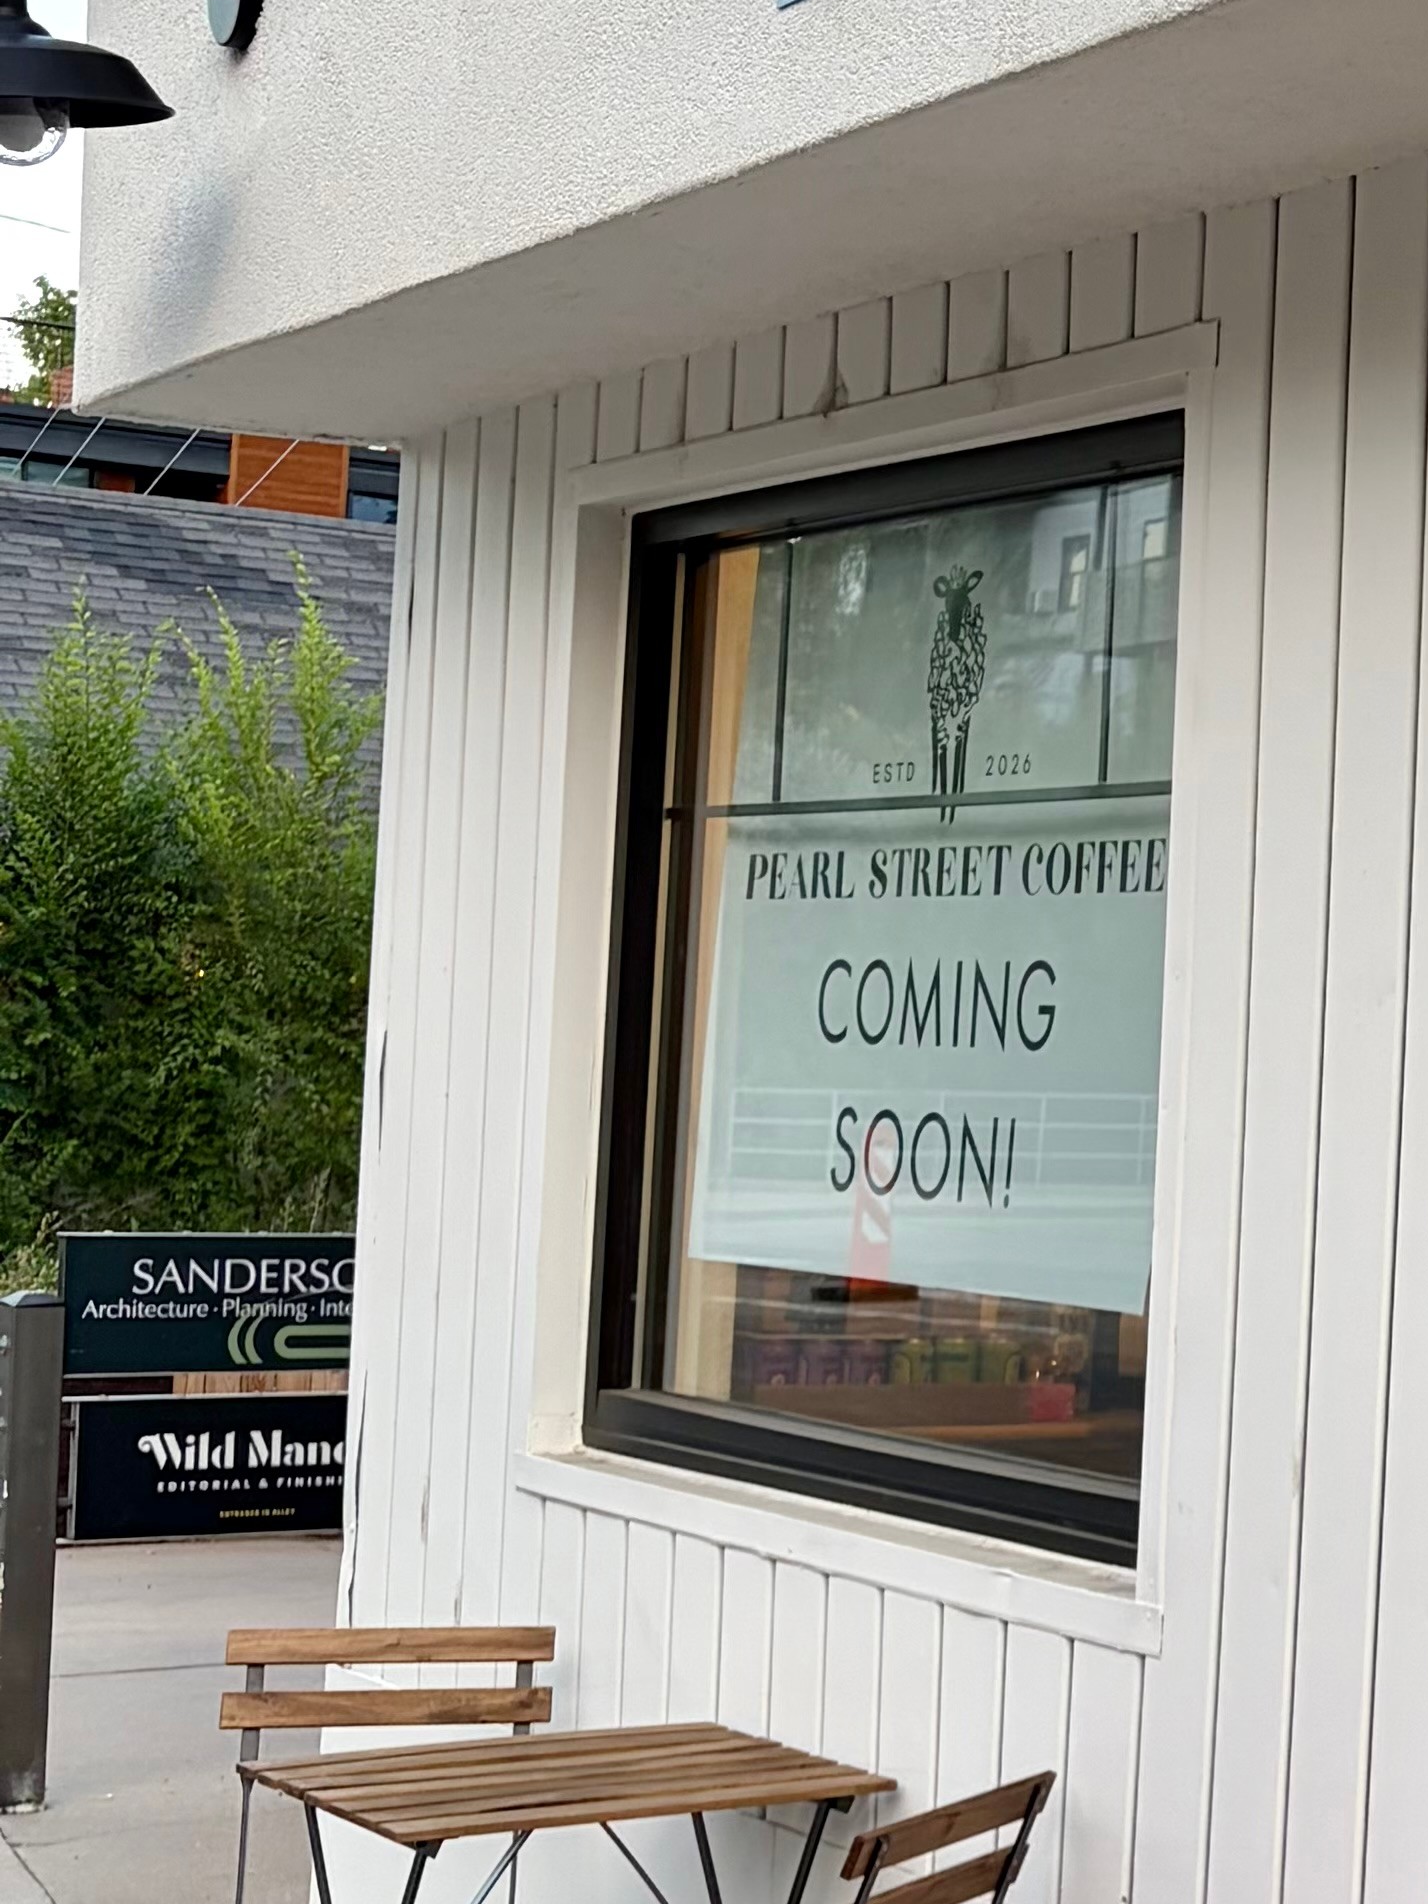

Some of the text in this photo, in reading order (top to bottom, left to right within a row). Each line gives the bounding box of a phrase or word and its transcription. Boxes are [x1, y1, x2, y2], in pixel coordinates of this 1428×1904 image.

[872, 753, 1033, 785] ESTD 2026
[745, 837, 1168, 900] PEARL STREET COFFEE
[818, 957, 1058, 1053] COMING
[829, 1106, 1018, 1210] SOON!
[81, 1298, 209, 1320] Architecture
[221, 1298, 308, 1323] Planning
[137, 1431, 236, 1472] Wild
[156, 1479, 251, 1494] EDITORIAL
